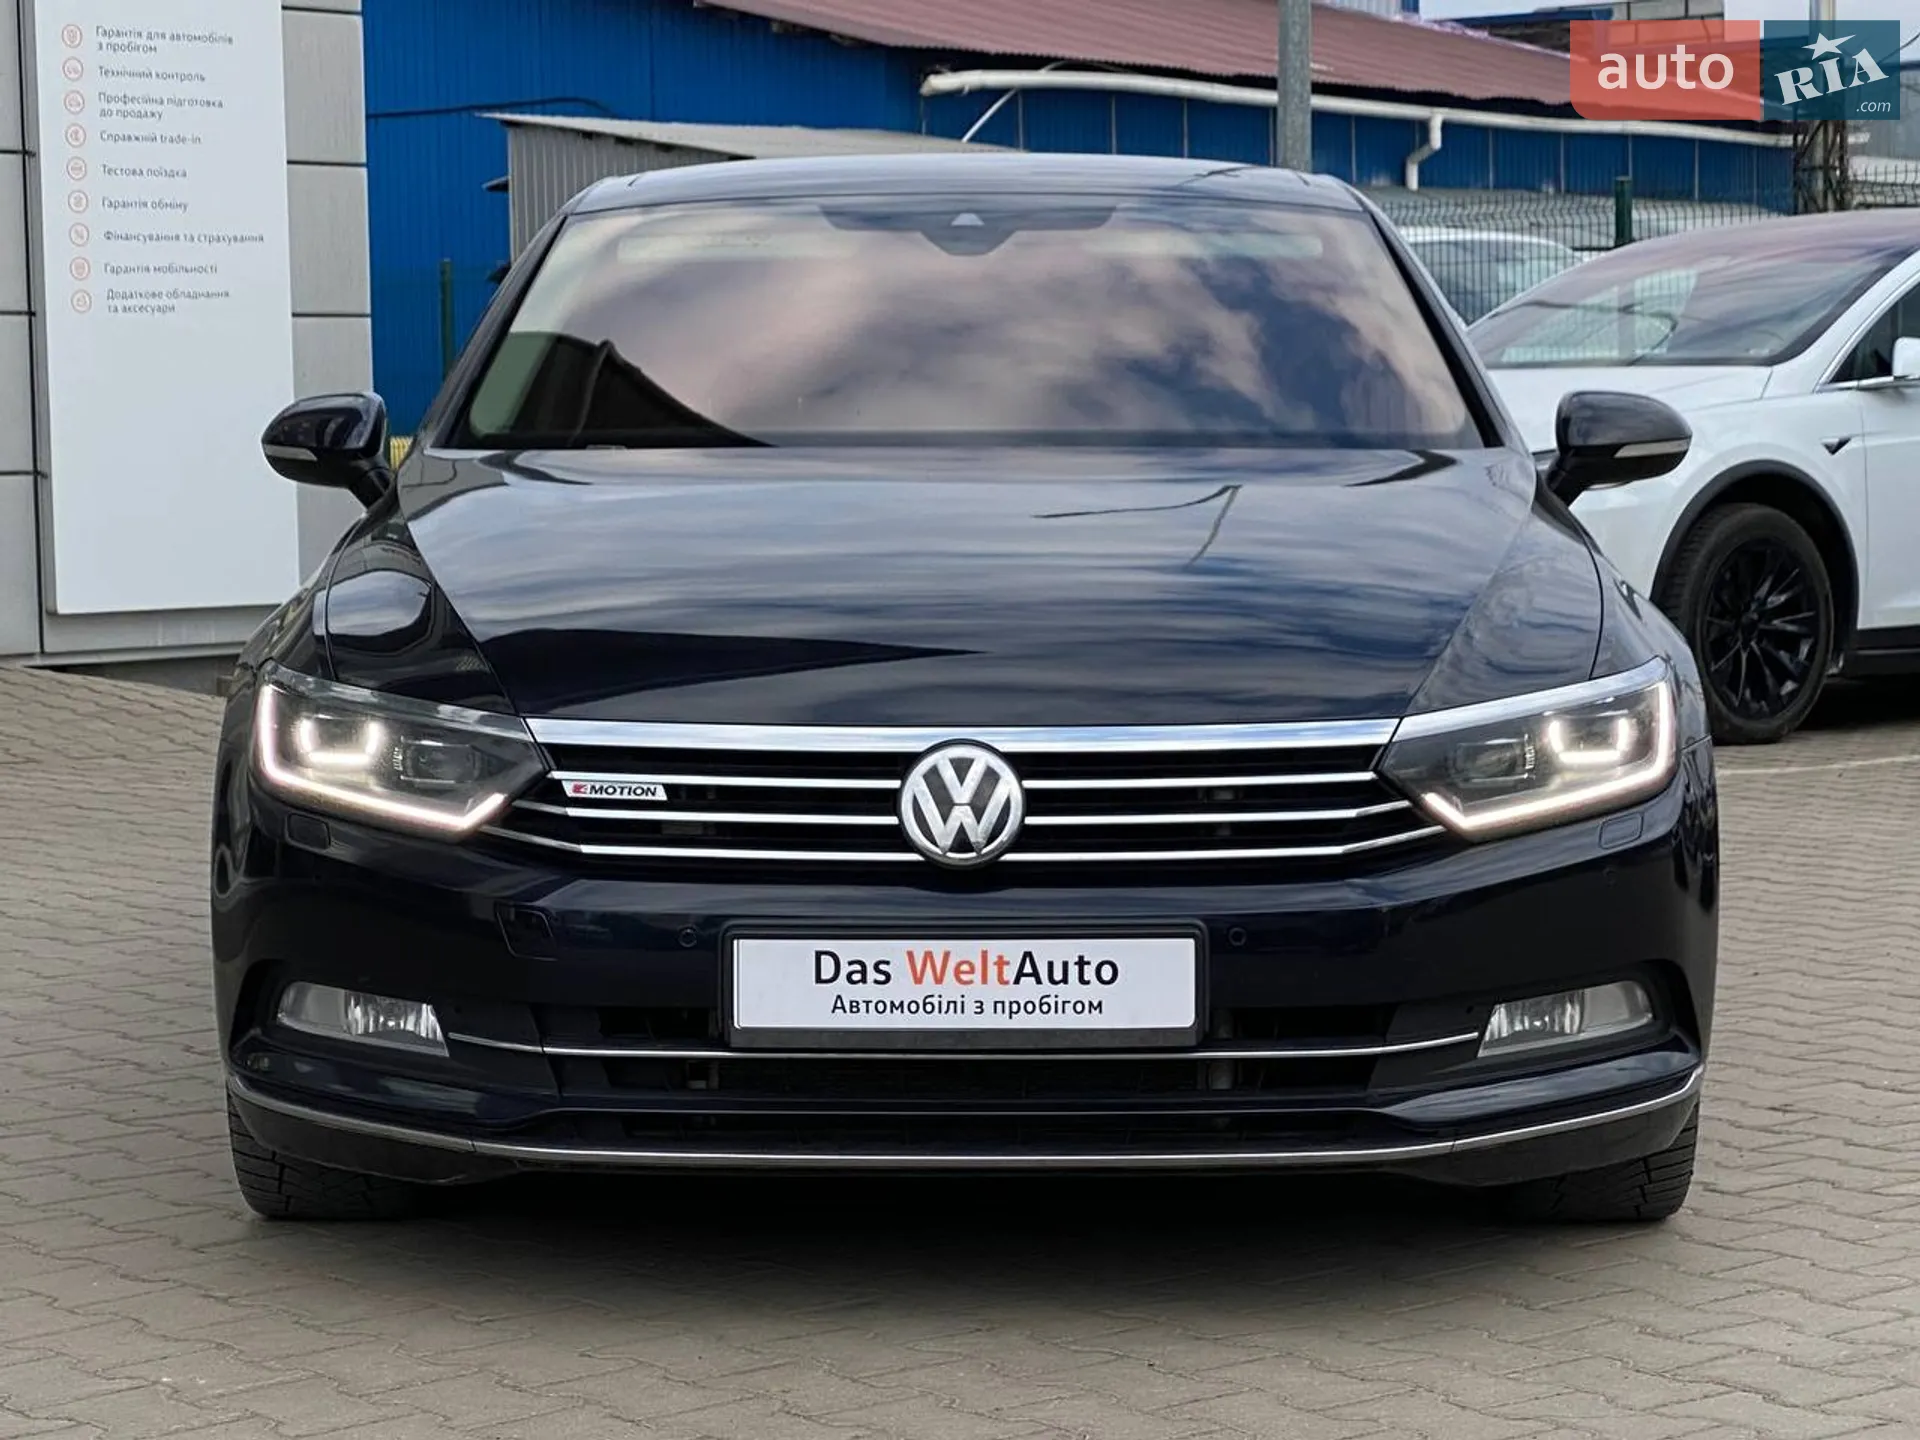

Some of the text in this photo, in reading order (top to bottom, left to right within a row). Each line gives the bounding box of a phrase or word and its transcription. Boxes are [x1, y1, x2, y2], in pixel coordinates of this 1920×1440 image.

[96, 26, 234, 45] Гарантія для автомобілів
[106, 41, 157, 53] пробігом
[98, 66, 206, 83] Технічний контроль
[98, 92, 224, 109] Професійна підготовка
[99, 108, 163, 120] до продажу
[100, 130, 202, 144] Справжній trade-in
[102, 164, 188, 179] Тестова поїздка
[101, 198, 188, 213] Гарантія обміну
[103, 230, 265, 246] Фінансування та страхування
[103, 262, 218, 276] Гарантія мобільності
[106, 288, 230, 302] Додаткове обладнання
[107, 303, 176, 315] та аксесуари
[814, 949, 1120, 986] Das WeltAuto
[831, 994, 1104, 1020] Автомобілі з пробігом
